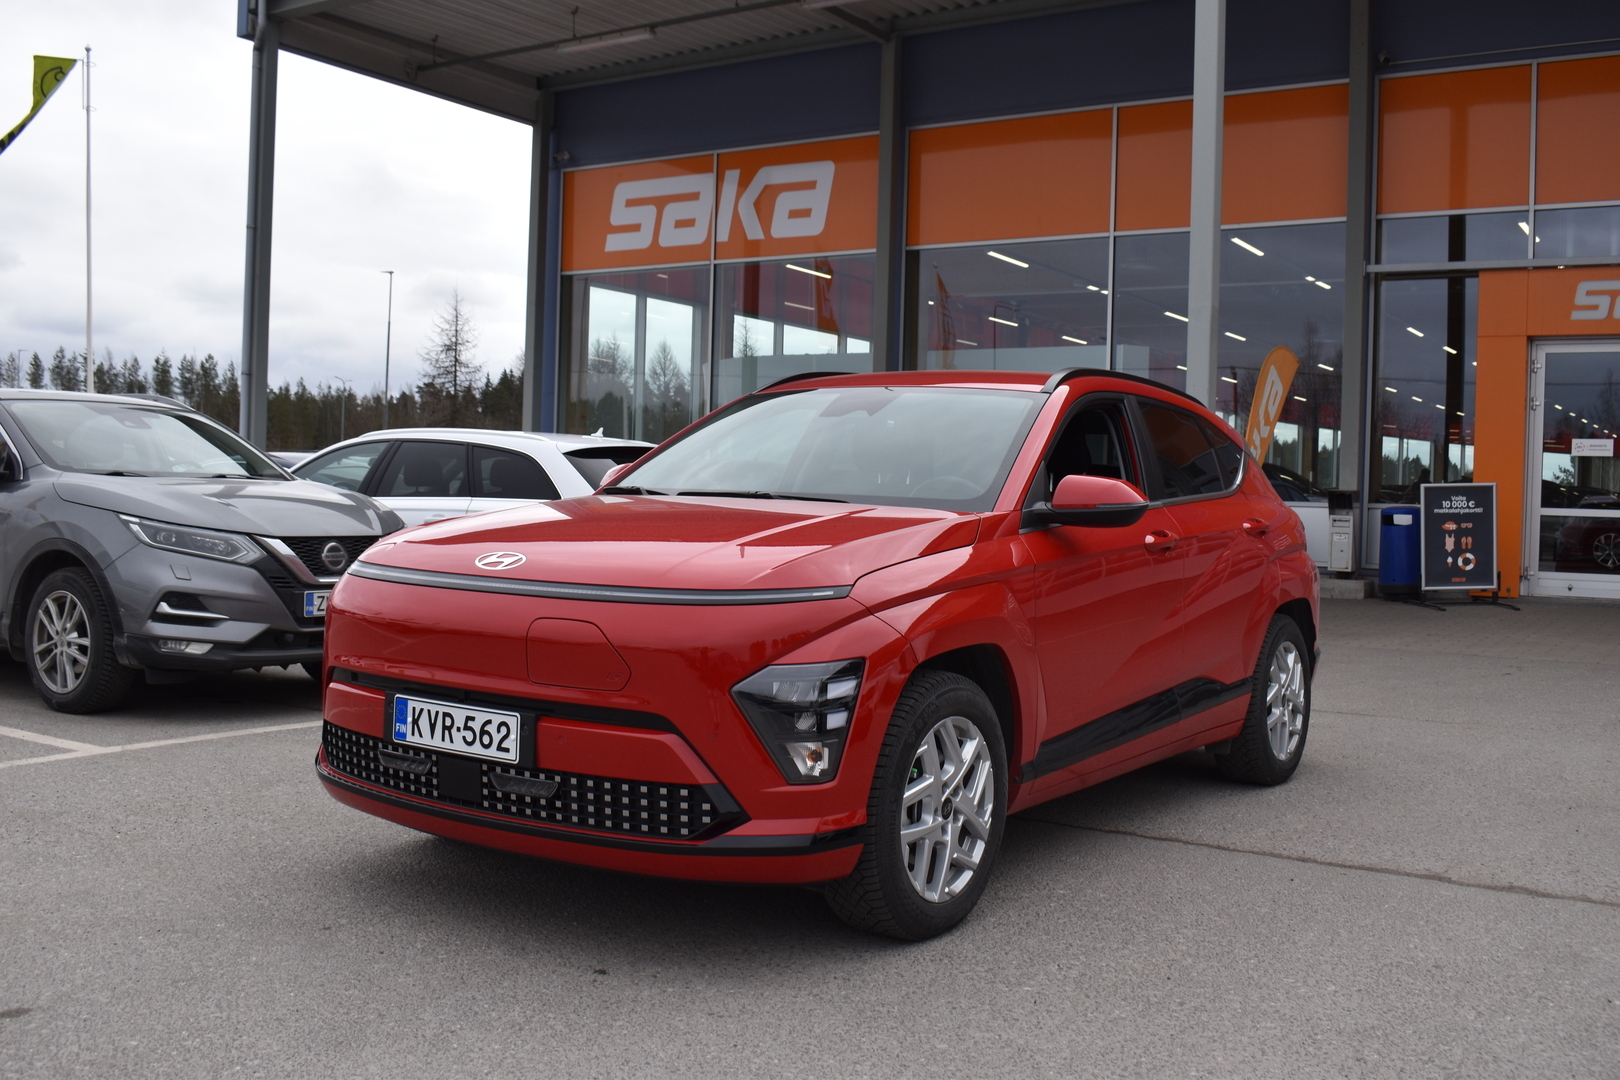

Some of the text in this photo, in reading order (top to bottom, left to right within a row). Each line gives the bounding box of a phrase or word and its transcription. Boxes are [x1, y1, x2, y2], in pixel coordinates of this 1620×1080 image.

[1570, 279, 1620, 320] s
[396, 723, 407, 734] FIN
[411, 706, 511, 753] KVR-562
